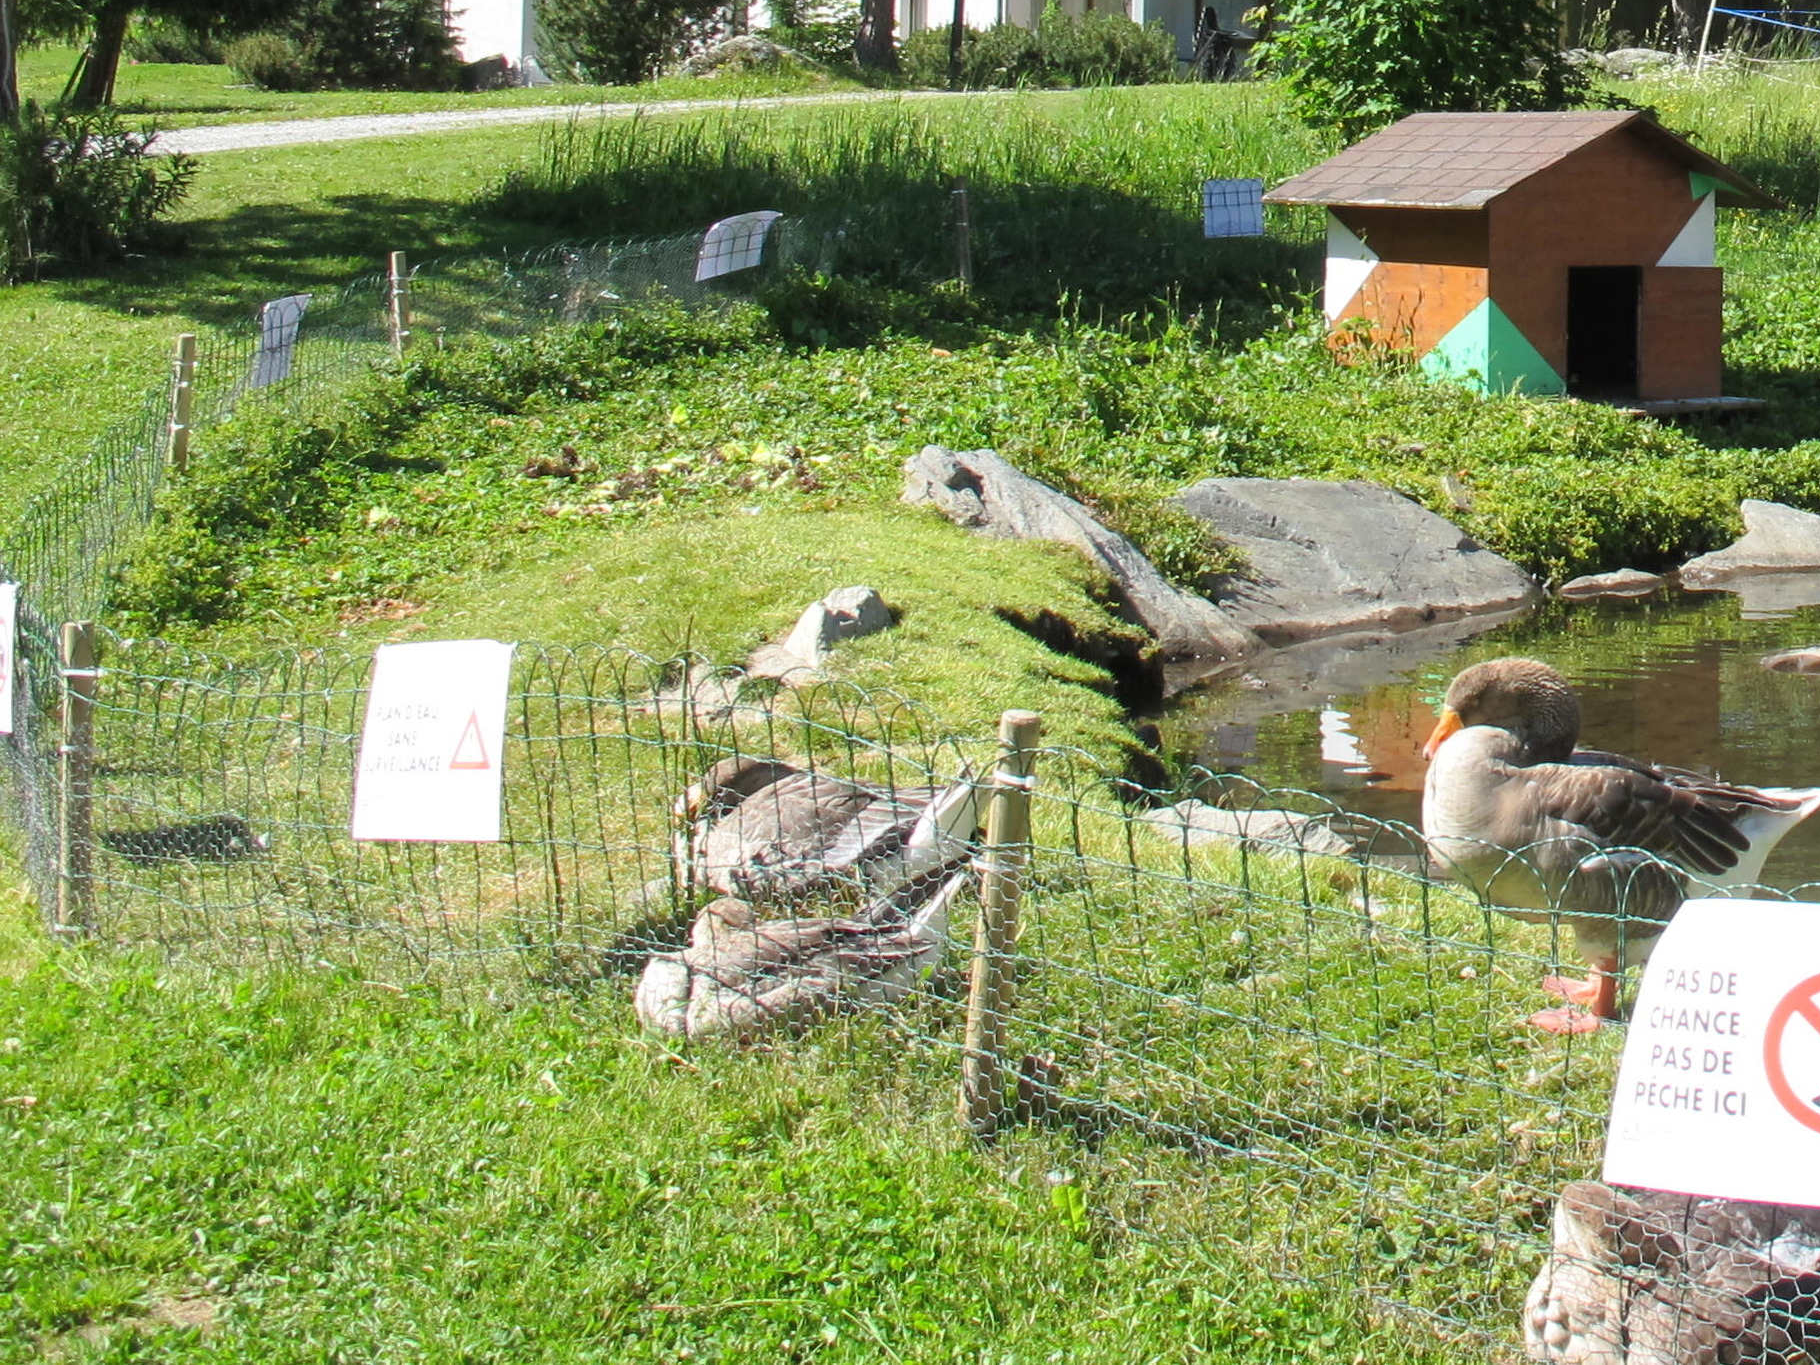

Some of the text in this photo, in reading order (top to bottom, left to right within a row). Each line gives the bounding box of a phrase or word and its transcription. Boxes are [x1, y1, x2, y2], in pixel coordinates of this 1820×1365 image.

[405, 703, 440, 721] DEAU
[1664, 968, 1738, 996] PAS DE
[1651, 1044, 1733, 1075] PAS DE
[1713, 1089, 1747, 1116] ICI
